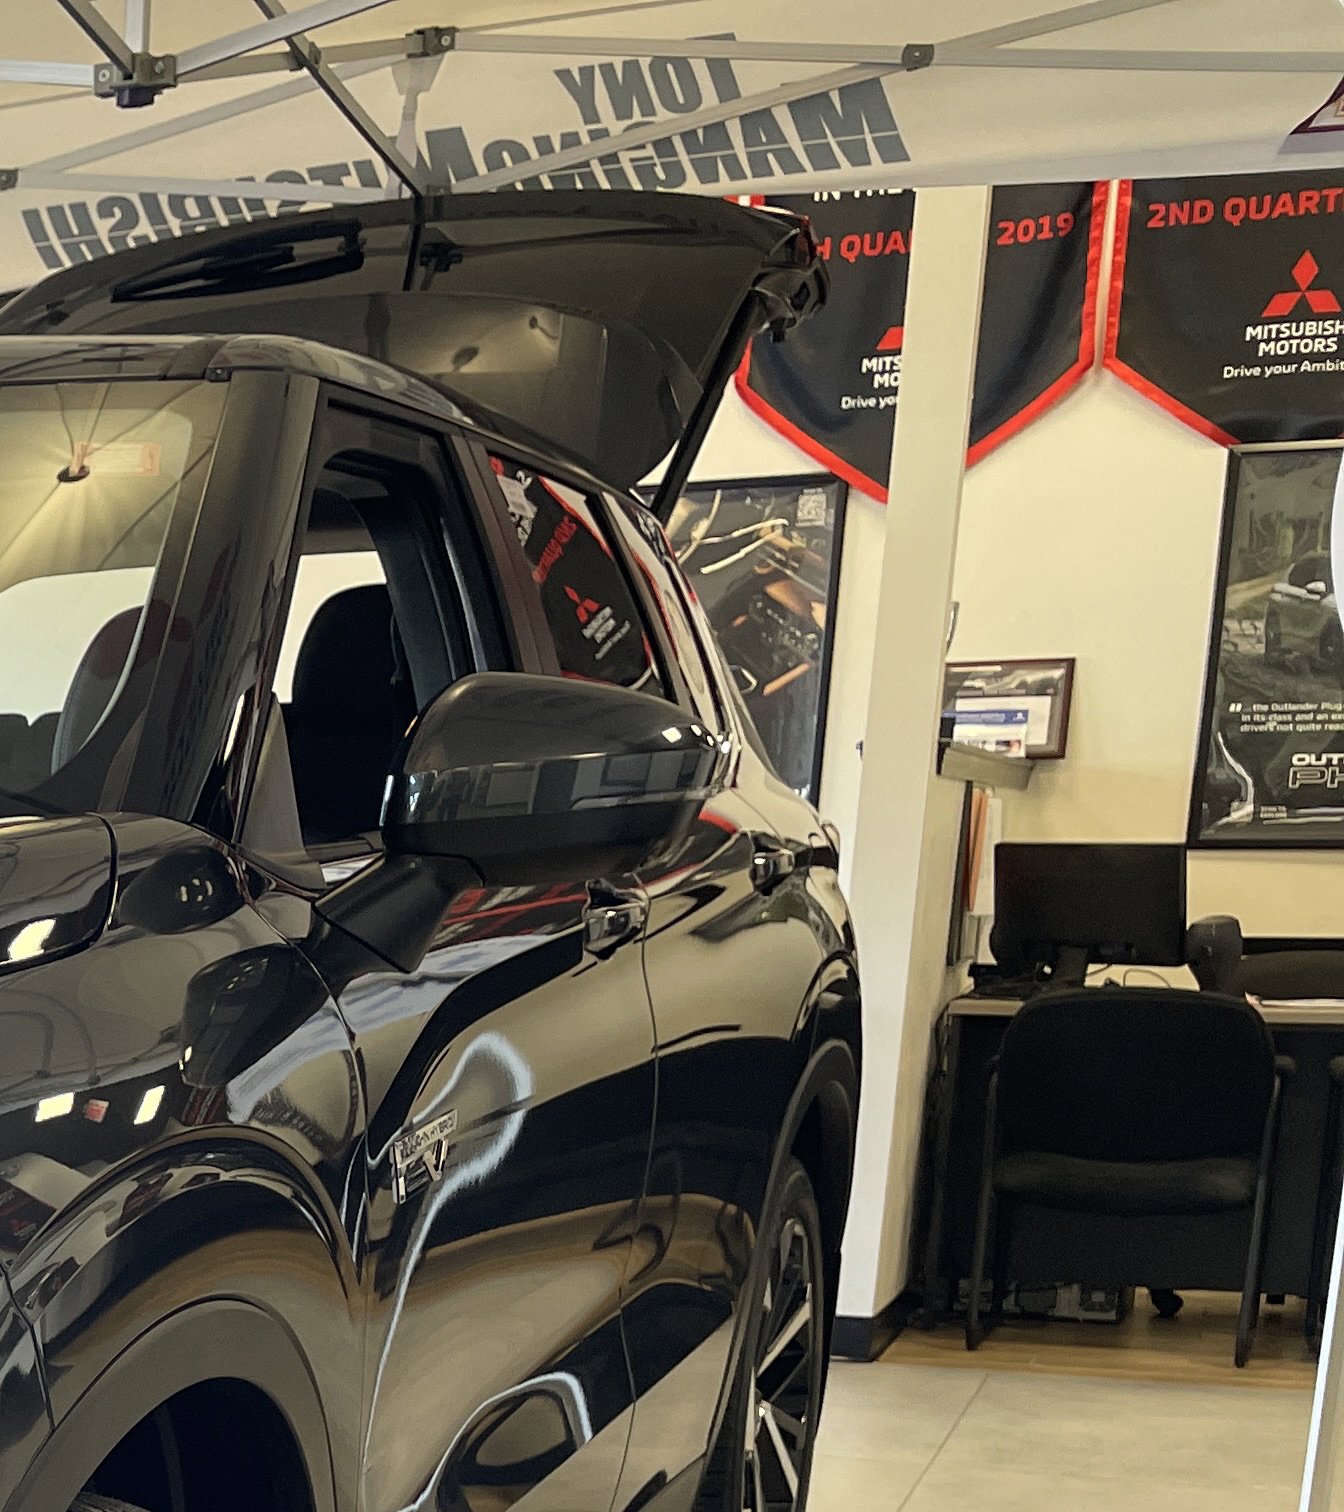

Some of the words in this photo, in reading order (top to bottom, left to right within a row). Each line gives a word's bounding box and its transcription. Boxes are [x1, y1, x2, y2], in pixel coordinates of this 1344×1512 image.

[1146, 198, 1215, 229] 2ND
[996, 211, 1075, 247] 2019
[1257, 337, 1339, 358] MOTORS
[1222, 364, 1262, 379] Drive
[1264, 361, 1298, 378] your
[840, 396, 877, 410] Drive
